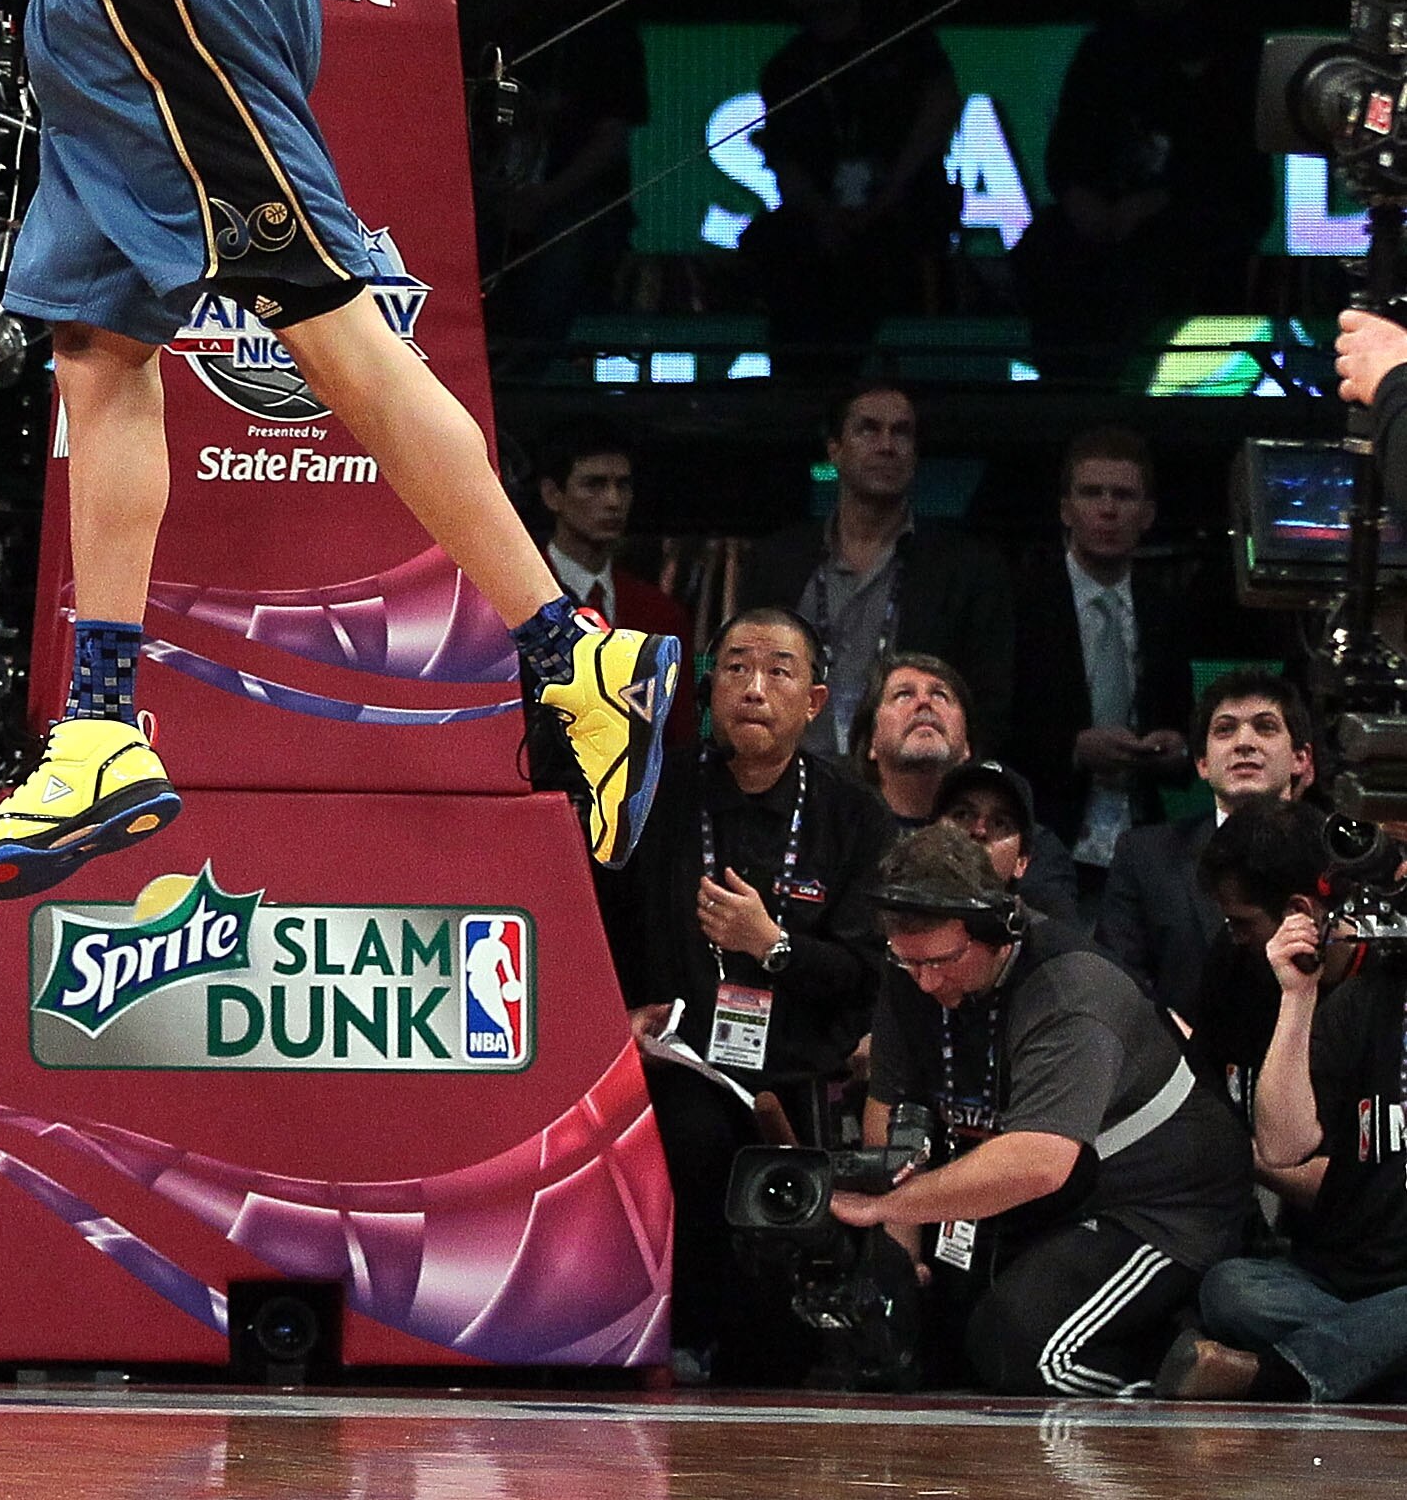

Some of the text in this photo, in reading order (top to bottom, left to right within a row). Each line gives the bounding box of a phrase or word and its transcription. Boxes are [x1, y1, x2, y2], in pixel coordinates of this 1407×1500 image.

[199, 341, 222, 350] LA
[237, 338, 294, 364] NIG
[247, 425, 327, 440] Presented by
[197, 446, 378, 483] State Farm
[62, 896, 453, 1012] Sprite SLAM
[205, 984, 507, 1059] DUNK NBA
